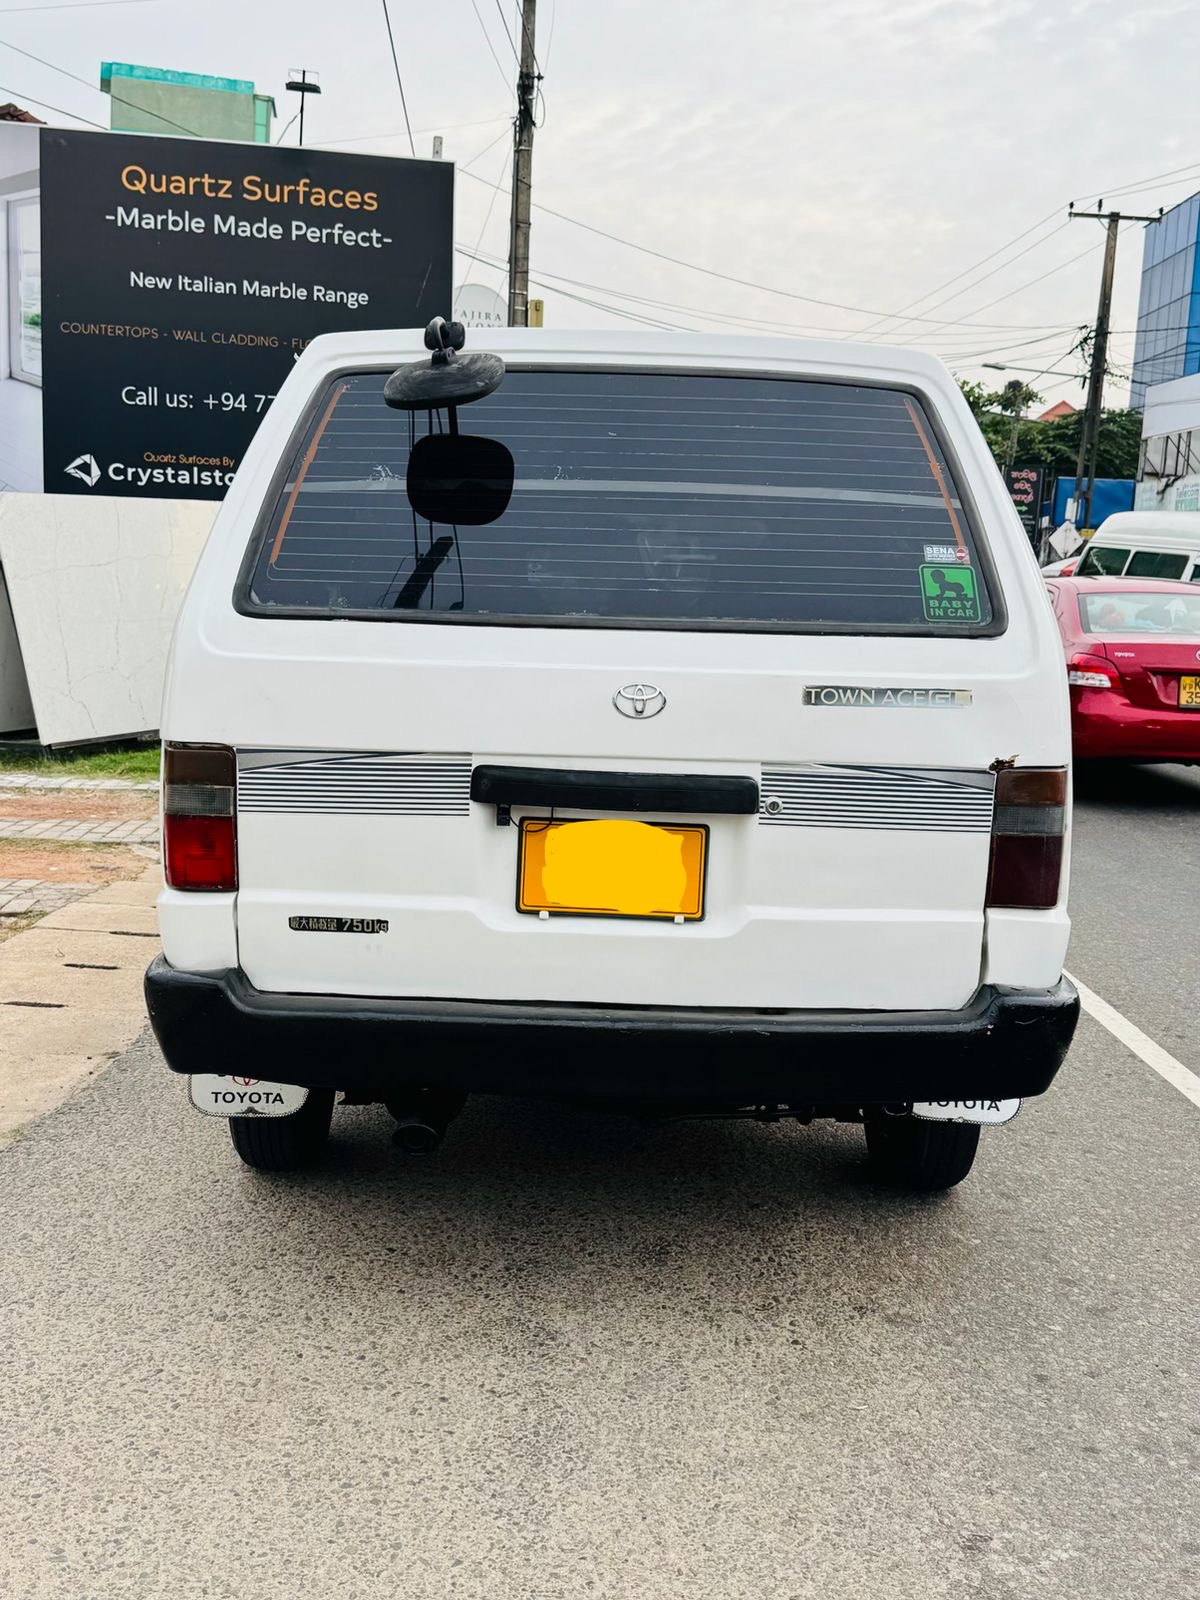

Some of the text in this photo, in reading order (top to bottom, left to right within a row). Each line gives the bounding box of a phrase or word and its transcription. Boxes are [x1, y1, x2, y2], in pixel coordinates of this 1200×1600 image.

[121, 165, 379, 211] Quartz Surfaces
[105, 206, 393, 249] -Marble Made Perfect-
[130, 271, 369, 309] New Italian Marble Range
[60, 321, 159, 339] COUNTERTOPS
[173, 330, 207, 343] WALL
[211, 332, 279, 348] CLADDING
[121, 386, 158, 406] Call
[165, 393, 194, 409] us:
[203, 392, 248, 412] +94
[143, 452, 235, 468] Quartz Surfaces By
[929, 600, 973, 609] BABY
[930, 608, 974, 617] IN CAR
[805, 688, 875, 705] TOWN
[882, 690, 926, 706] ACE
[211, 1091, 285, 1105] TOYOTA
